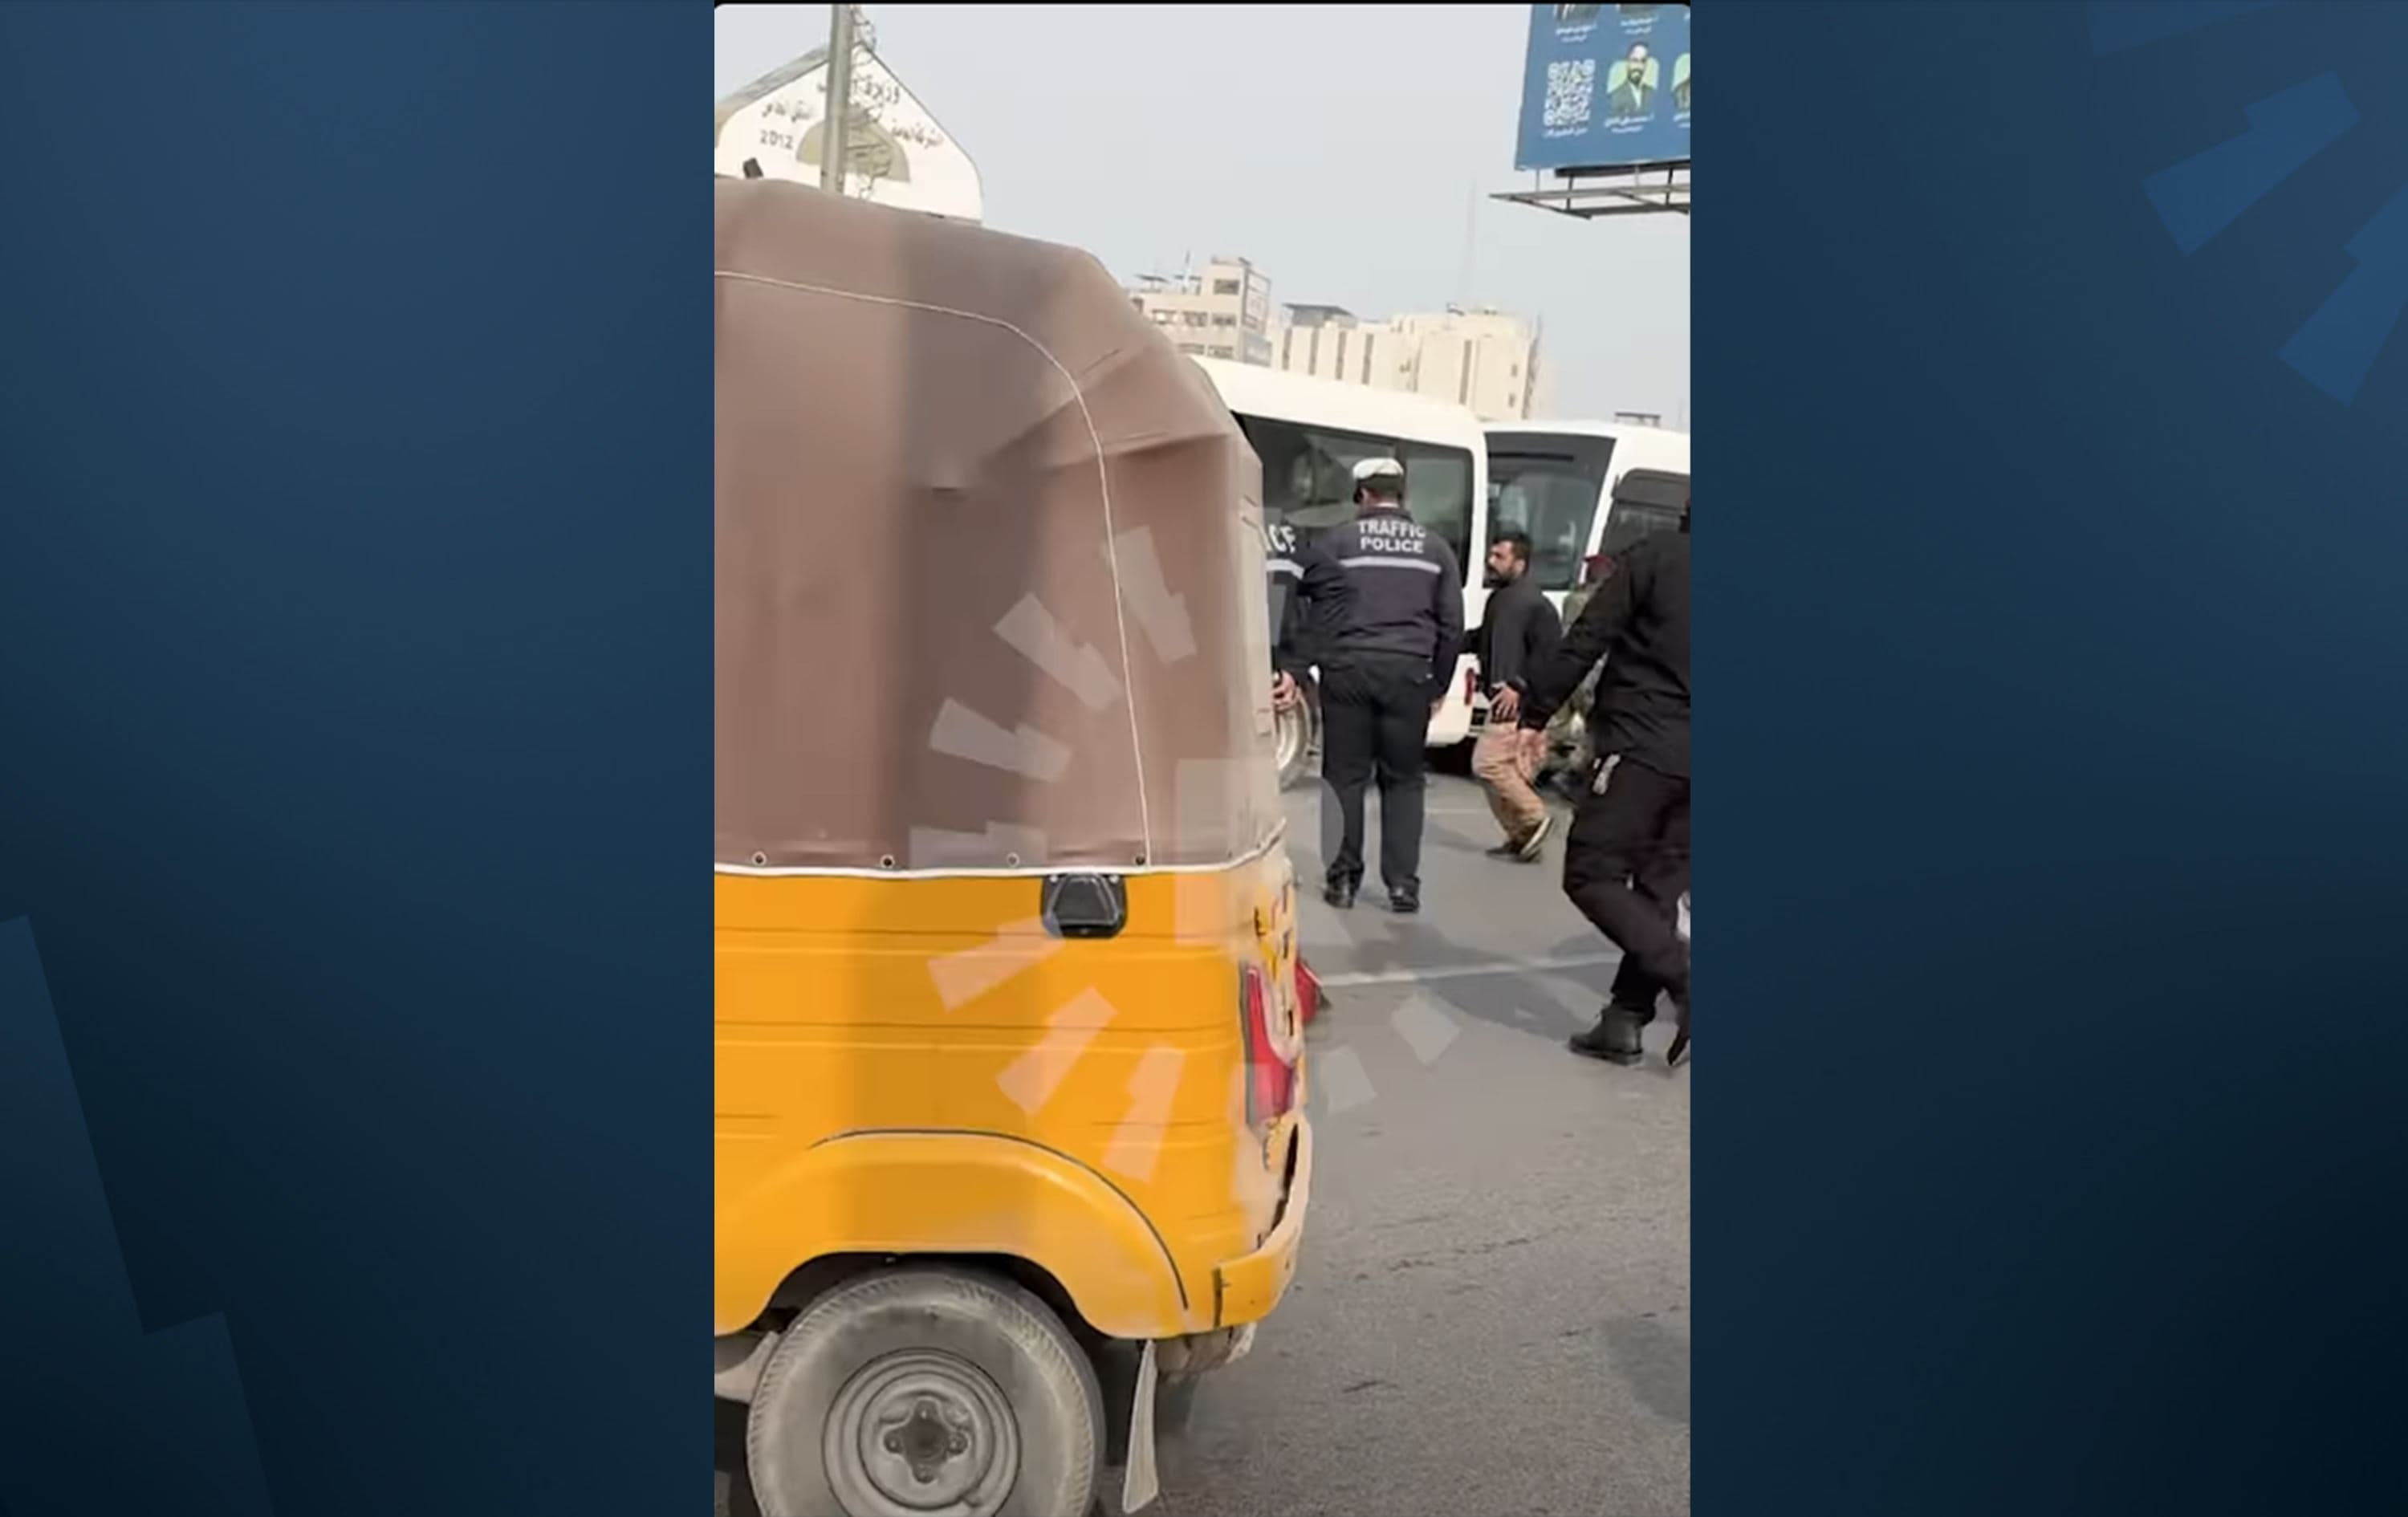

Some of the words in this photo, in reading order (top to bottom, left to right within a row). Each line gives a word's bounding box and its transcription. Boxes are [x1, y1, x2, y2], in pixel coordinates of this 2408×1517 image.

[759, 128, 794, 150] 2012
[1358, 519, 1427, 539] TRAFFIC
[1361, 535, 1425, 554] POLICE
